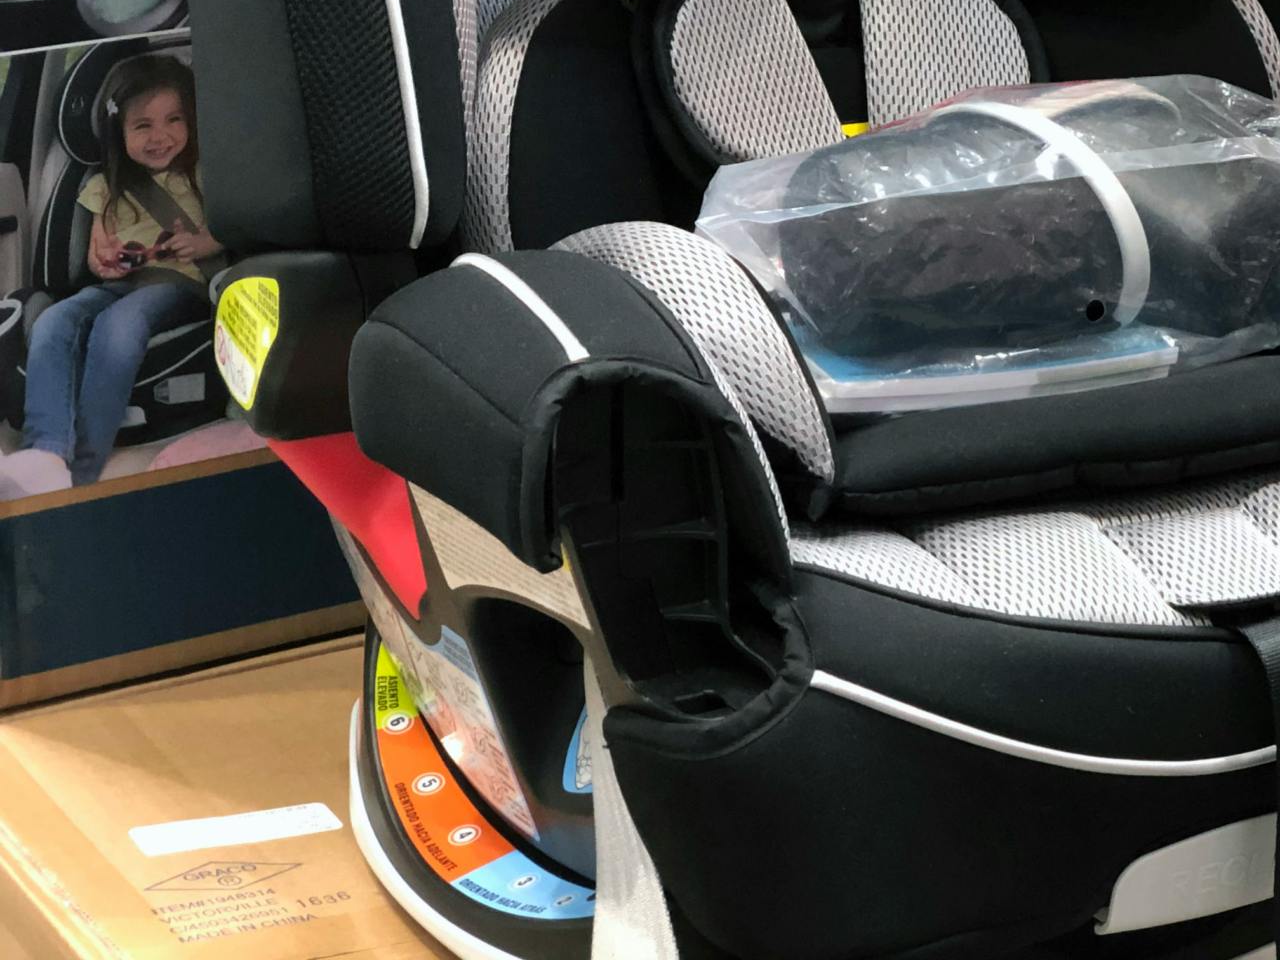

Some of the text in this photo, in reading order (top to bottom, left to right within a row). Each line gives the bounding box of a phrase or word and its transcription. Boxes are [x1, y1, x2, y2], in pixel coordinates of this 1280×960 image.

[377, 675, 388, 711] ELEVADO
[388, 675, 399, 709] ASIENTO
[390, 716, 405, 727] 6
[421, 777, 437, 788] 5
[394, 782, 420, 823] ORIENTADO
[426, 843, 458, 871] ADELANTE
[459, 830, 473, 840] 4
[183, 863, 257, 882] GRACO
[458, 878, 500, 902] ORIENTADO
[261, 913, 319, 928] CHINA
